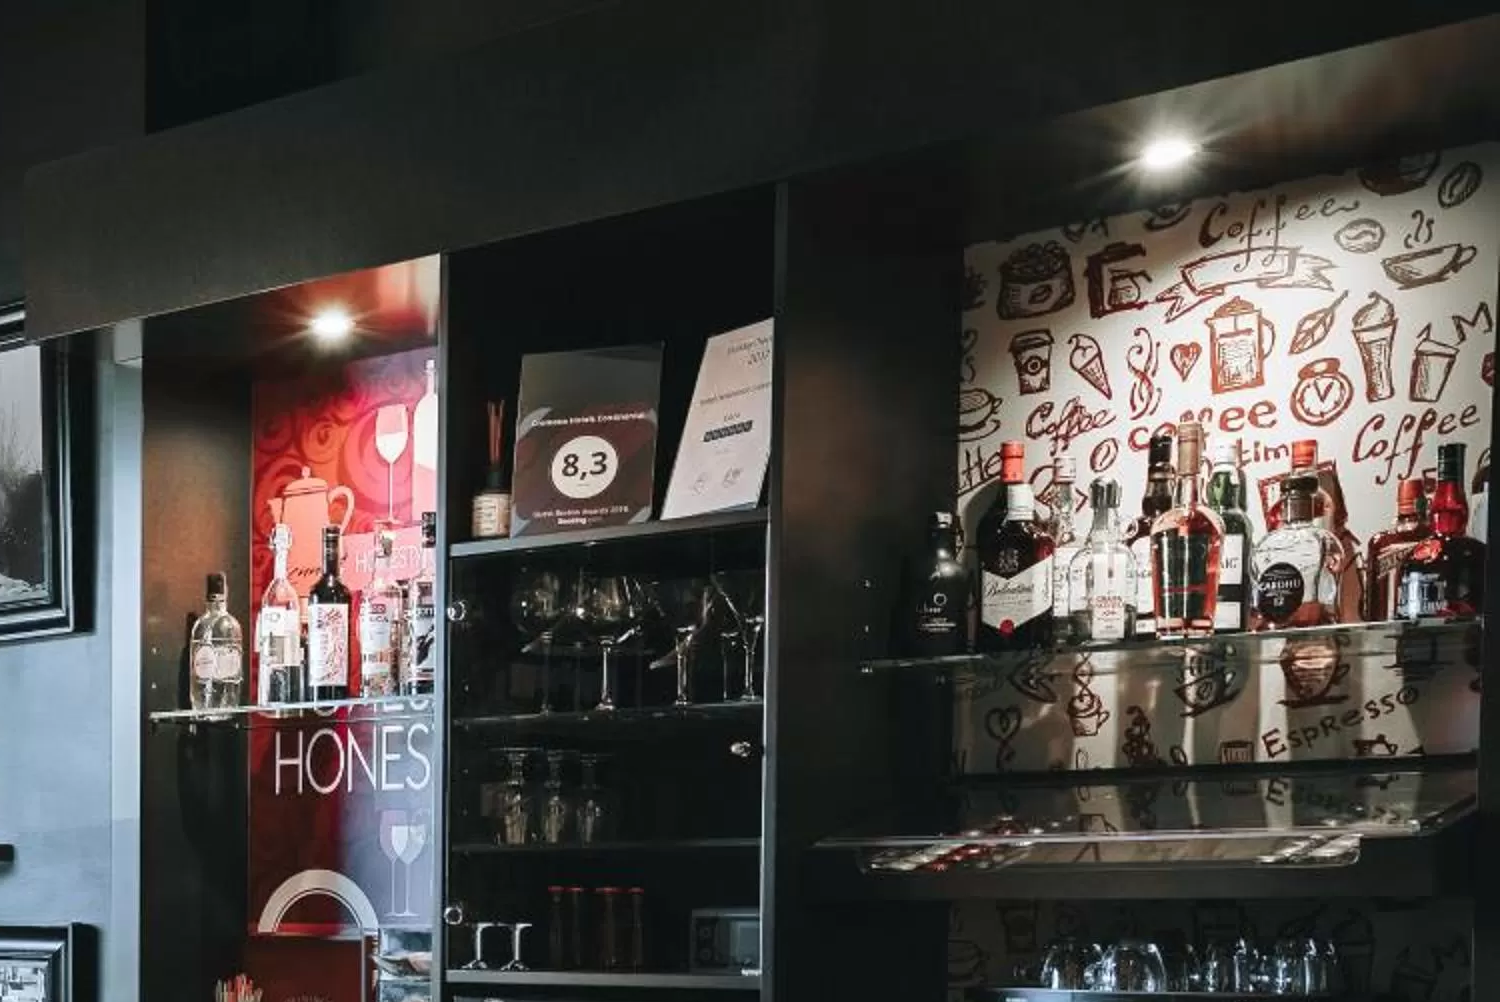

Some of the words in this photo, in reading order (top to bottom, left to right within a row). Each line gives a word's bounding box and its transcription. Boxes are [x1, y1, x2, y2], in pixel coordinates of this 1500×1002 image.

[1199, 194, 1361, 272] Coffee
[1026, 397, 1117, 456] Coffee
[1352, 403, 1481, 486] Coffee
[561, 451, 608, 480] 8,3
[1261, 686, 1420, 759] Espresso
[275, 724, 430, 795] HONES
